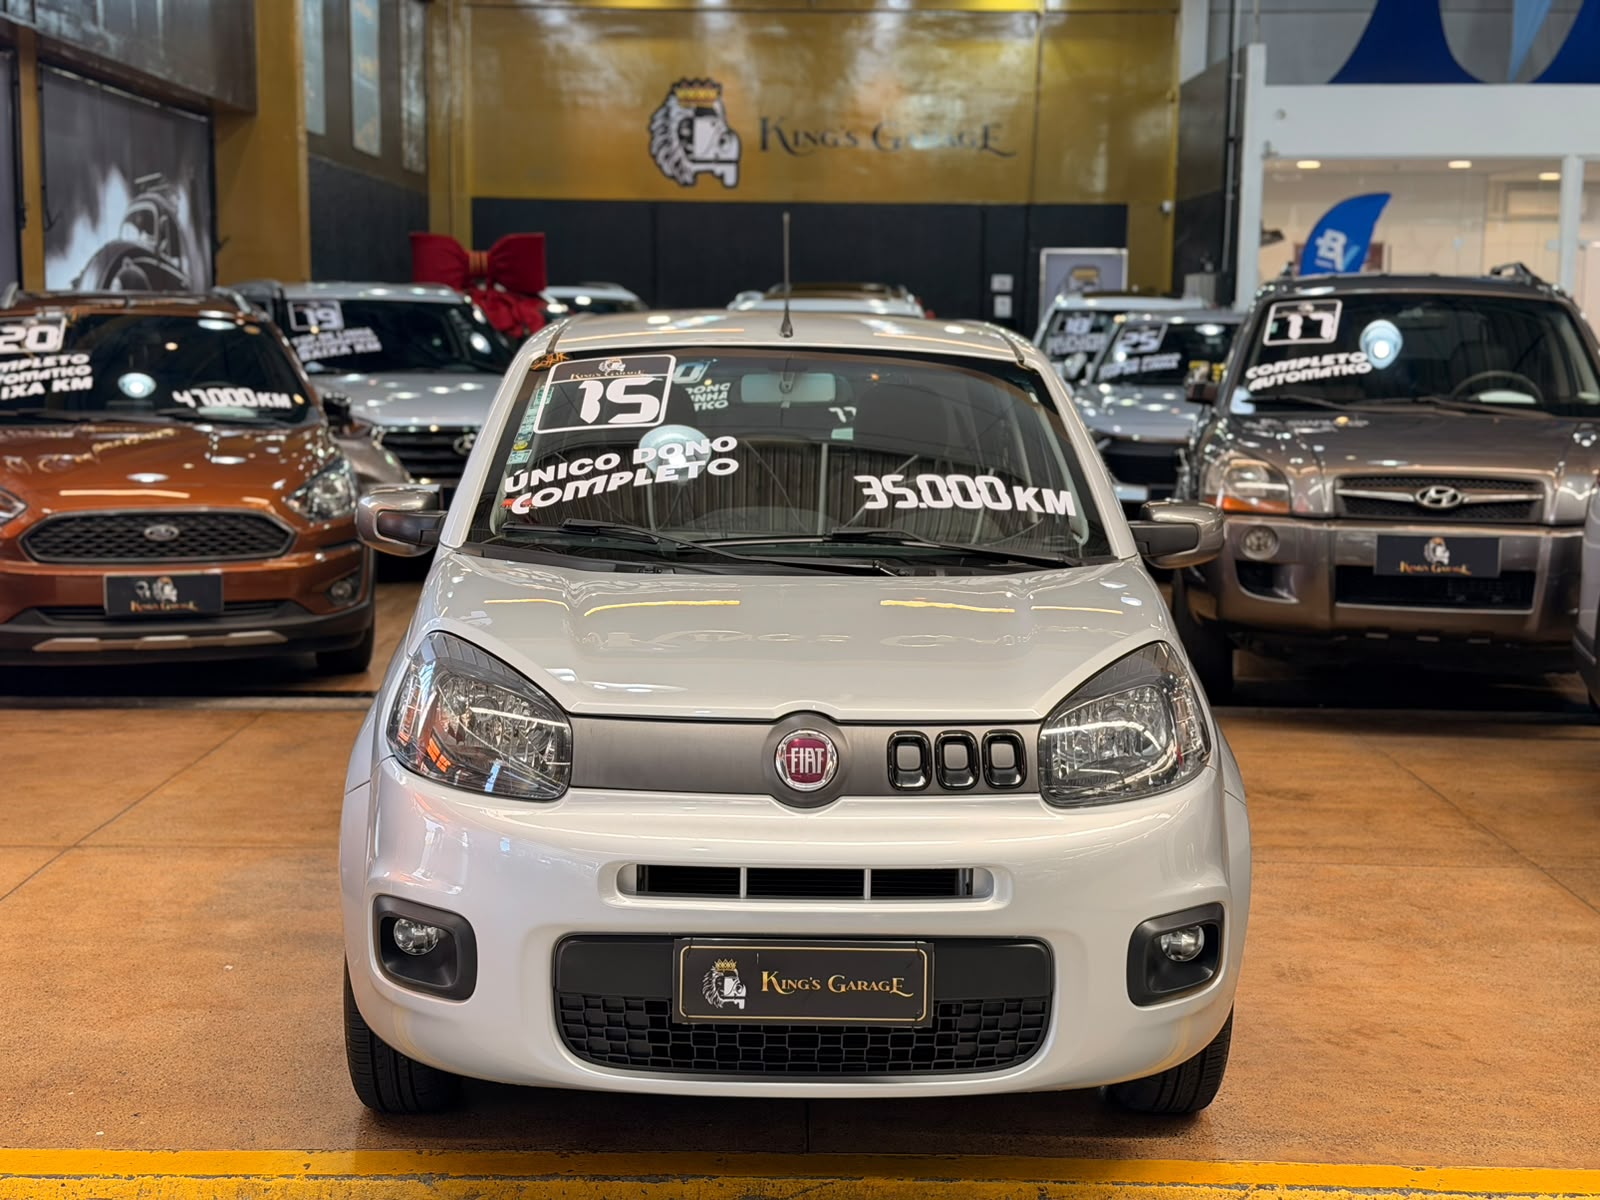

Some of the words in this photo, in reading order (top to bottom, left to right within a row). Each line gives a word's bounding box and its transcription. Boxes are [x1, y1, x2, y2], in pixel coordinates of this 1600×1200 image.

[0, 324, 60, 352] 20
[1287, 311, 1335, 339] 17
[1245, 351, 1368, 379] COMPLETO
[52, 375, 93, 393] KM
[577, 377, 664, 424] 15
[504, 453, 621, 493] ÚNICO
[633, 435, 738, 465] DONO
[511, 457, 739, 515] COMPLETO
[790, 747, 825, 774] FIAT
[761, 970, 821, 995] KING'S
[827, 974, 914, 998] GARAGE
